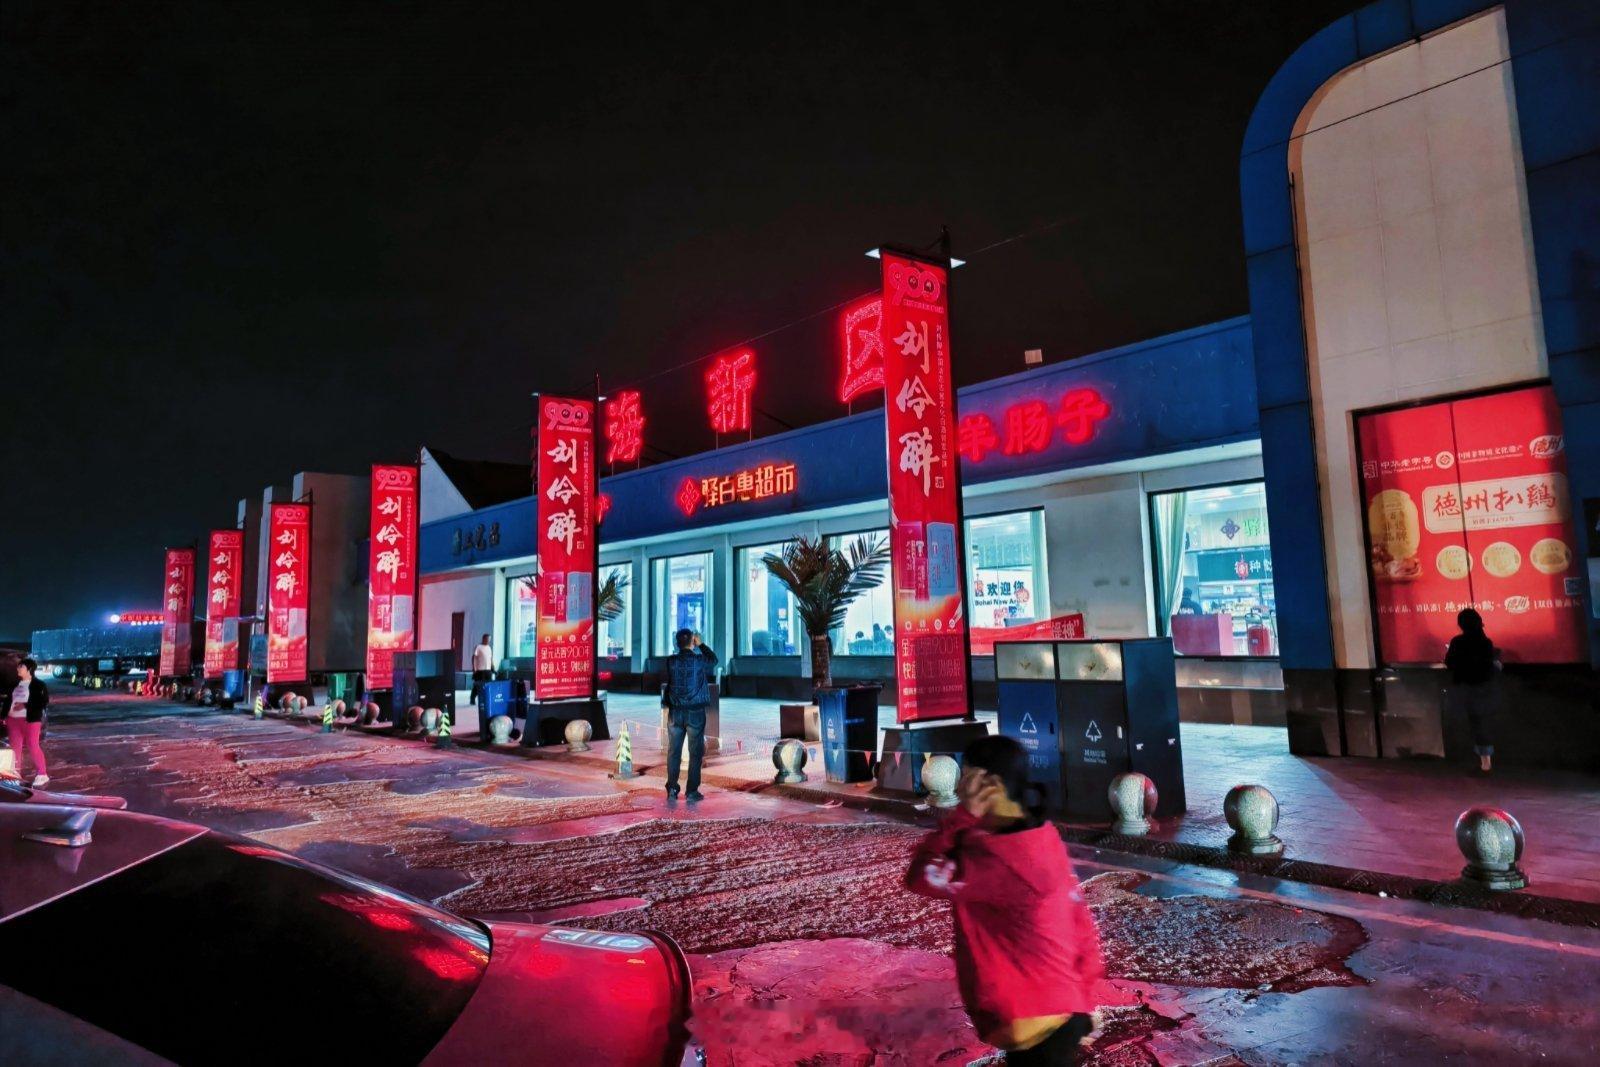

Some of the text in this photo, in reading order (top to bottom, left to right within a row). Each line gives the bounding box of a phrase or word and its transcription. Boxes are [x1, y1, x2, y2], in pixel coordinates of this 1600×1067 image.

[893, 320, 940, 497] 刘伶醉
[959, 388, 1110, 463] 羊肠子
[546, 438, 583, 556] 刘伶醉
[276, 528, 300, 599] 刘伶醉
[376, 495, 405, 584] 刘伶醉
[975, 599, 993, 607] Bohai
